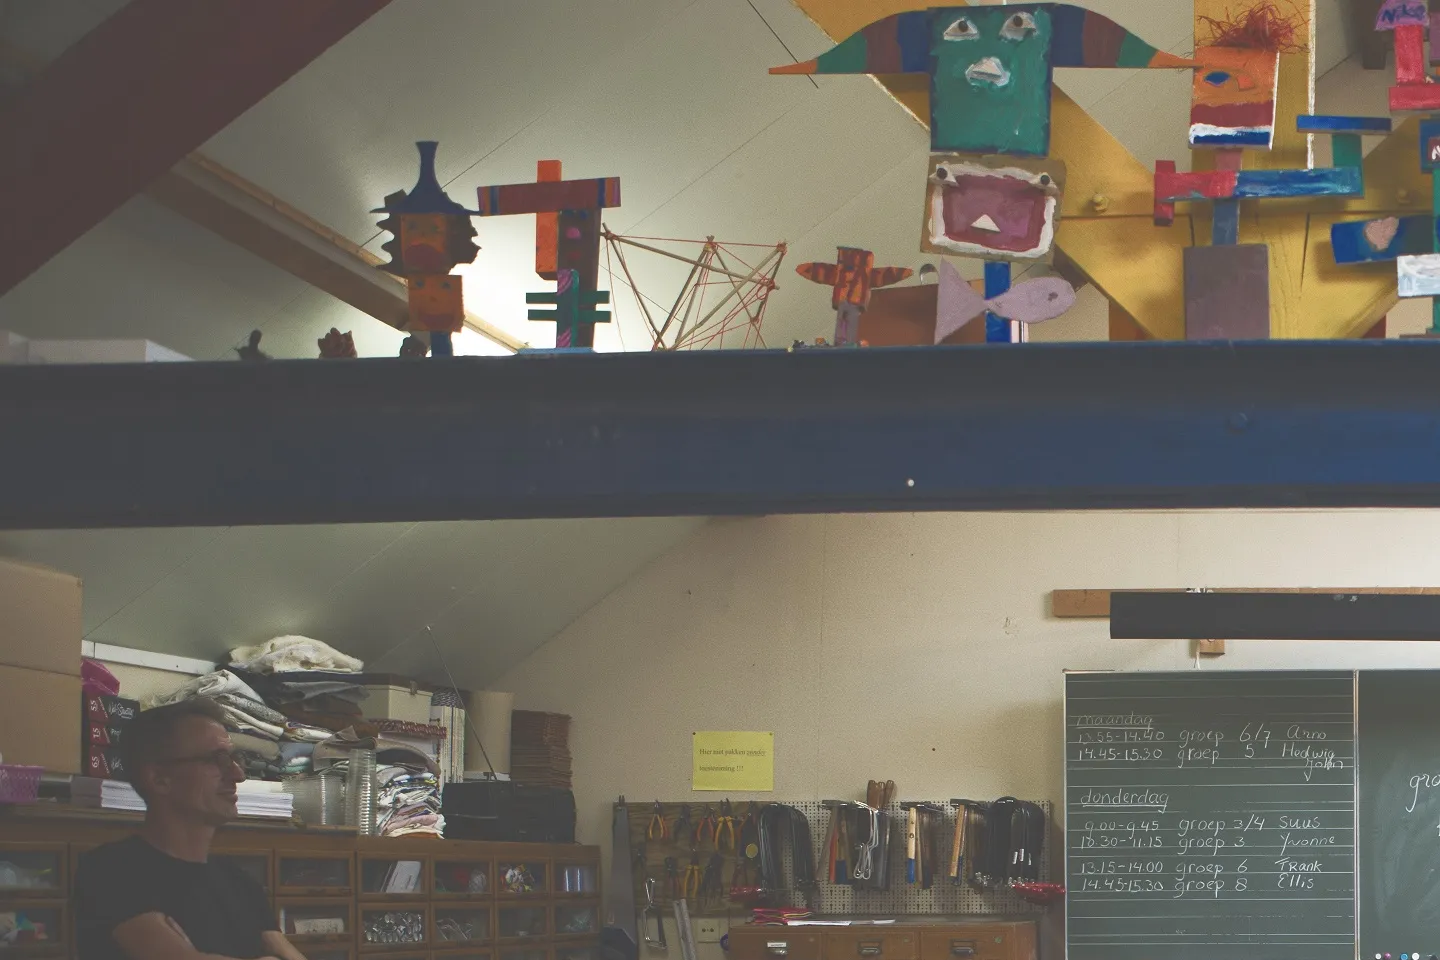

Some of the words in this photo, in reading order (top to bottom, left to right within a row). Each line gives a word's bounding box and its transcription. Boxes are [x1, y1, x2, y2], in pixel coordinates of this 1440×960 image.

[1076, 711, 1154, 733] maandag
[1178, 729, 1224, 749] groep
[1239, 722, 1271, 749] 6/7
[1177, 748, 1220, 769] groep
[1244, 743, 1255, 759] 5
[1080, 787, 1170, 814] donderdag
[1177, 819, 1226, 837] groep
[1233, 813, 1266, 832] 3/4
[1177, 837, 1225, 857] groep
[1234, 836, 1246, 848] 3
[1175, 862, 1224, 881] groep
[1237, 858, 1249, 874] 6
[1173, 879, 1225, 899] groep
[1235, 877, 1248, 892] 8
